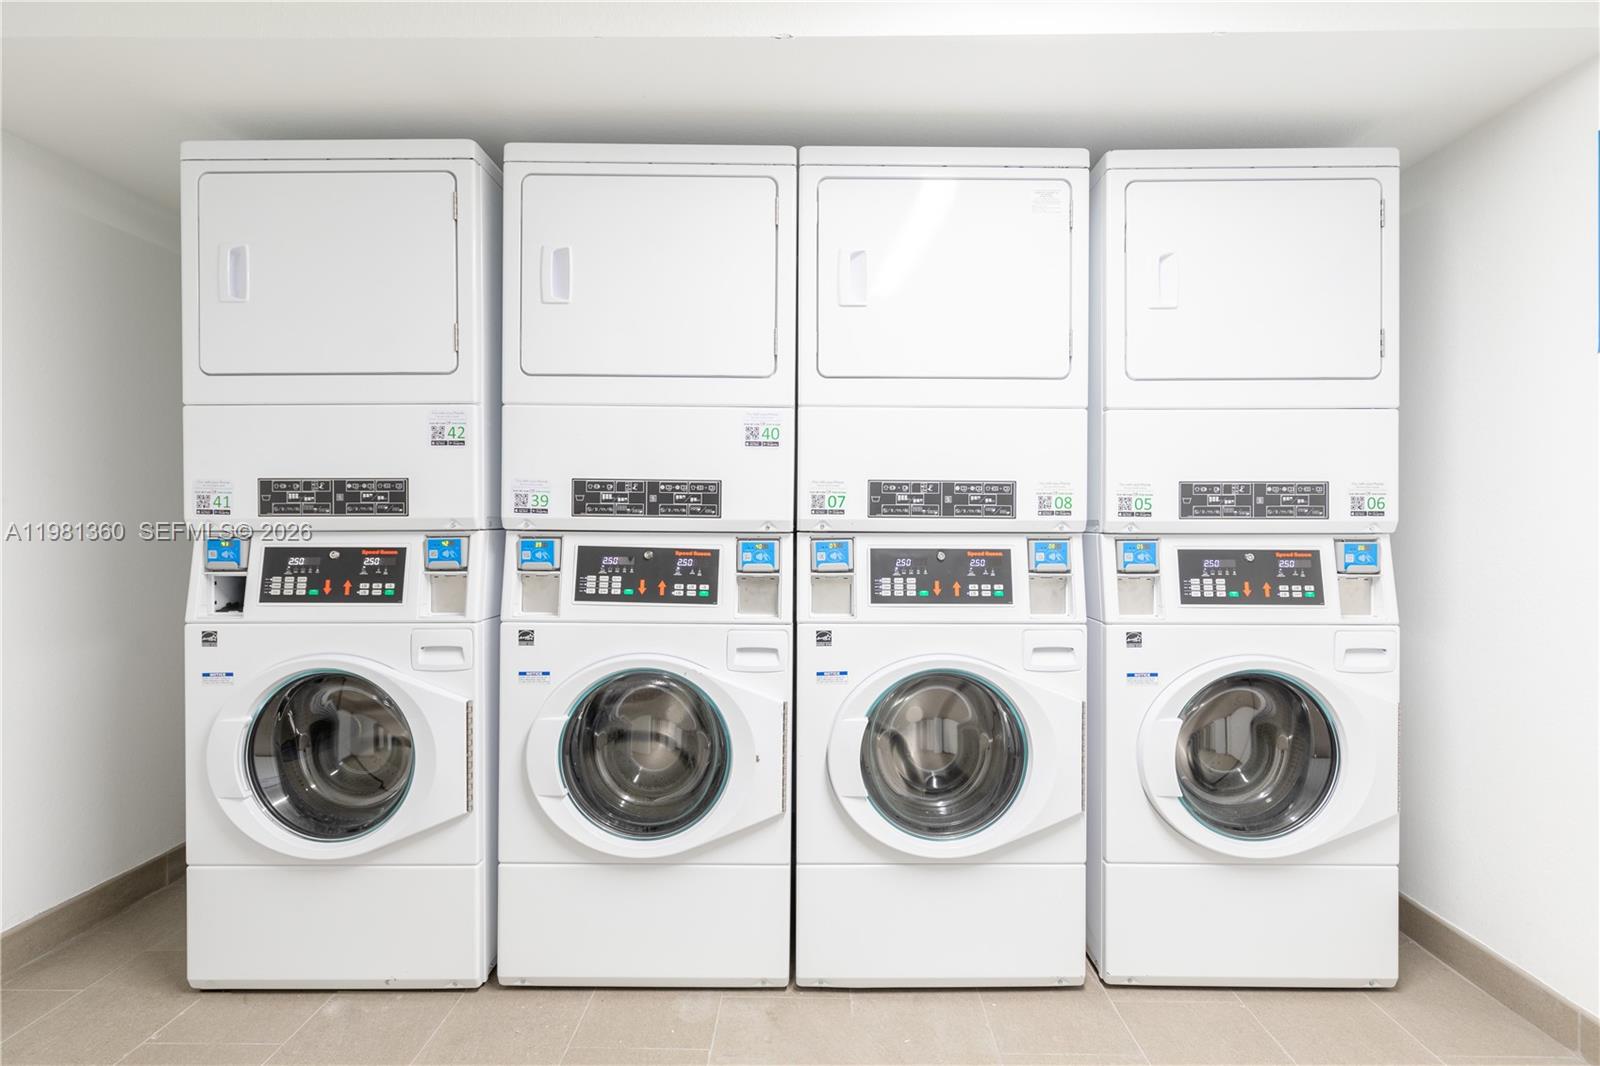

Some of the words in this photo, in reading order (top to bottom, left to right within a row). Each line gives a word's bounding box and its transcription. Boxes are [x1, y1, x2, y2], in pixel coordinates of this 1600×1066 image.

[447, 426, 465, 439] 42
[761, 427, 780, 441] 40
[213, 495, 231, 508] 41
[531, 494, 549, 507] 39
[827, 495, 846, 508] 07
[1054, 496, 1073, 509] 08
[1134, 497, 1152, 510] 05
[1367, 497, 1385, 510] 06
